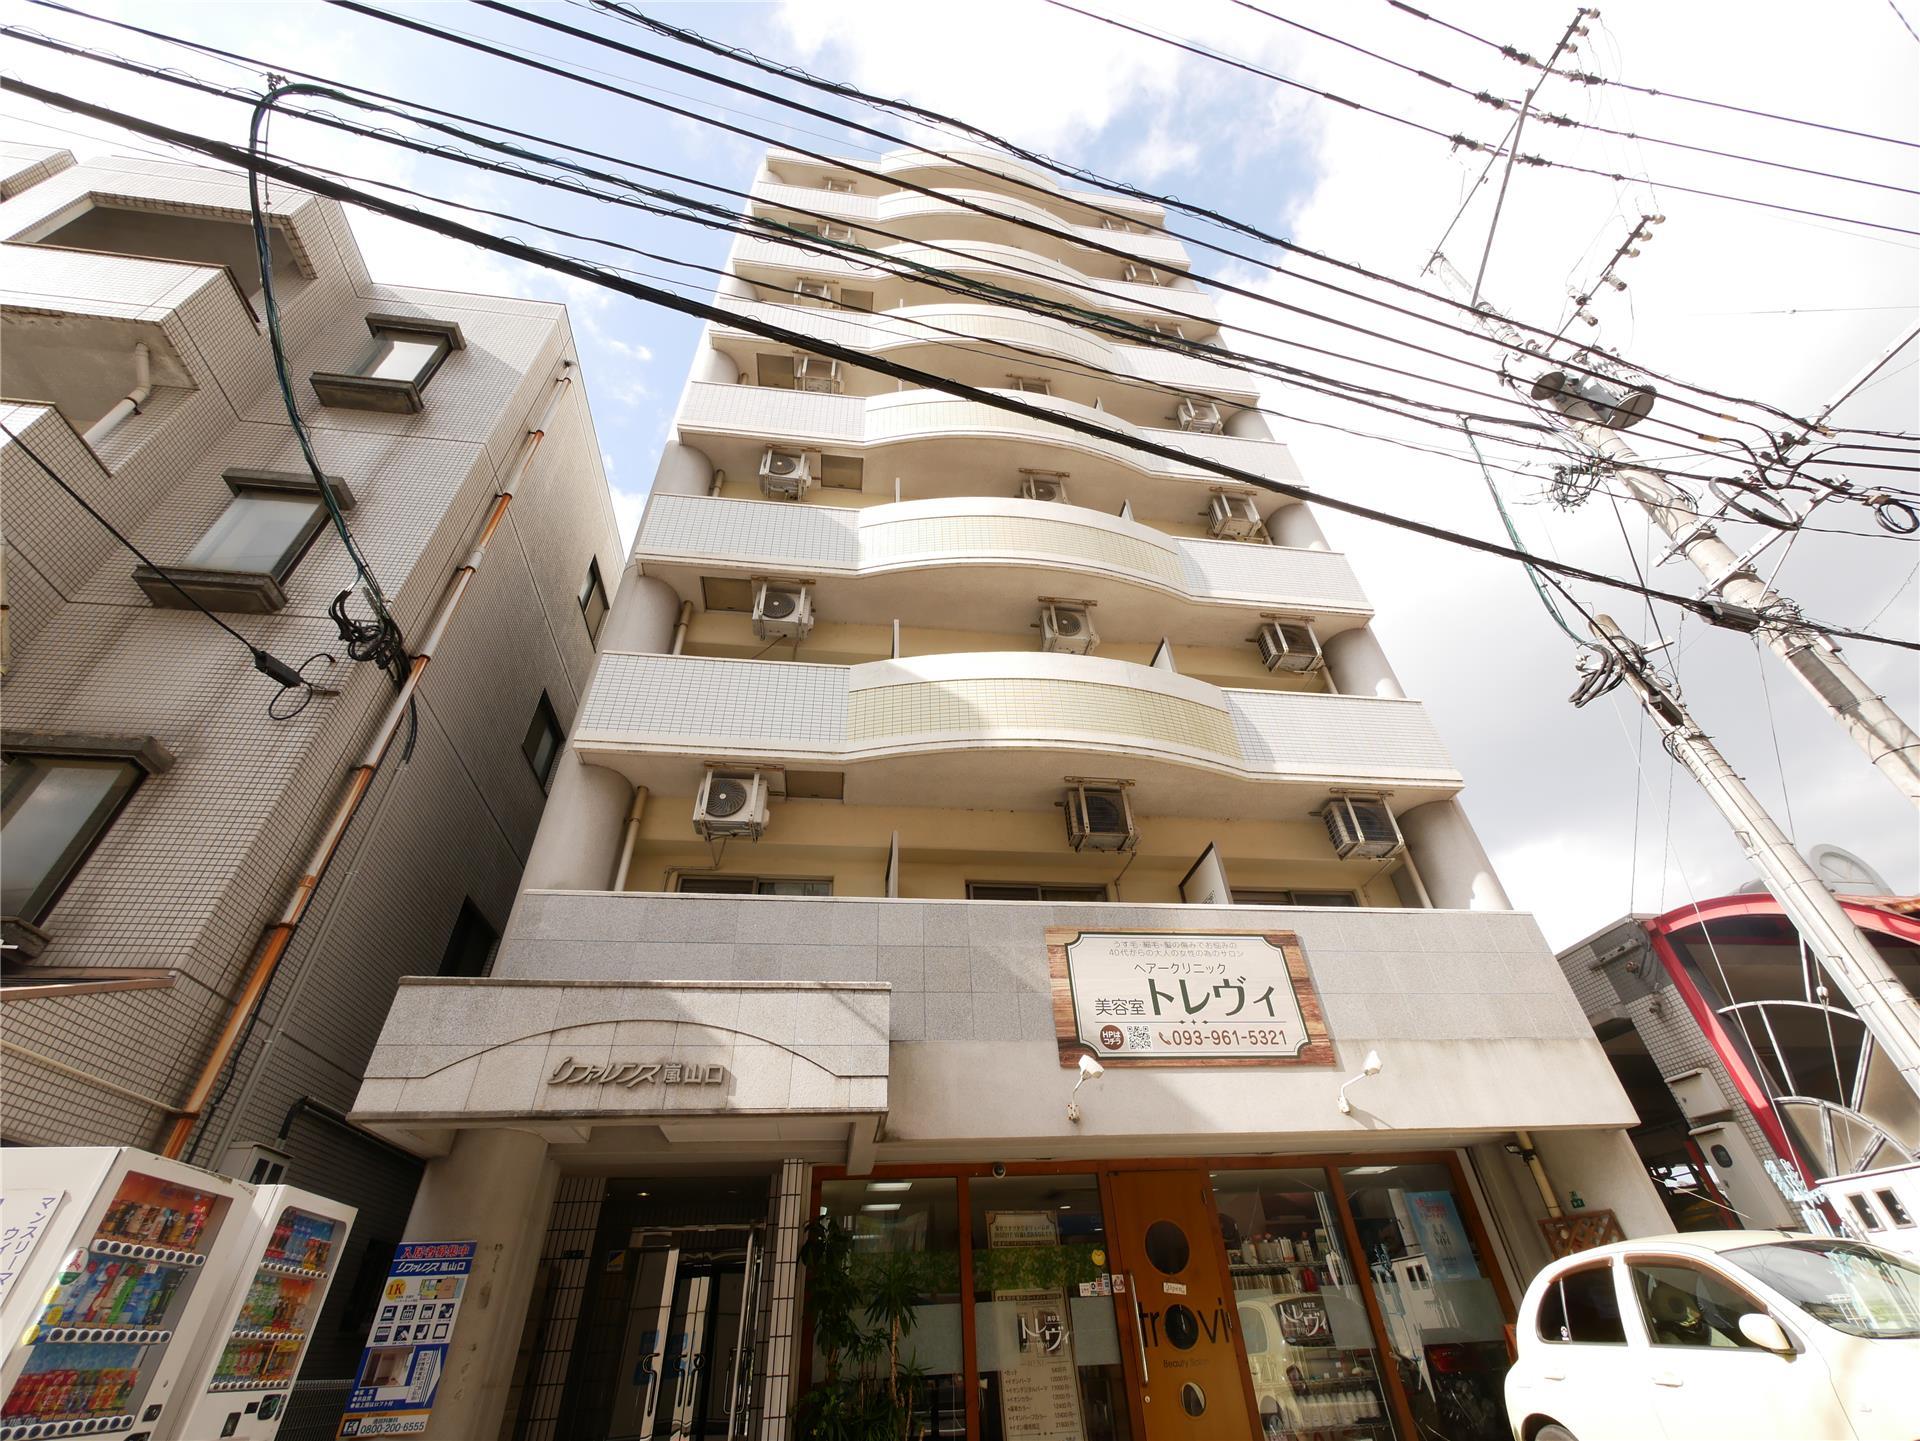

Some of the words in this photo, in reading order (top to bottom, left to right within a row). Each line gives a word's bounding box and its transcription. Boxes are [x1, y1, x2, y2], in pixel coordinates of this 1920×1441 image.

[1134, 962, 1226, 975] ヘアークリニック
[1095, 998, 1147, 1016] 美容室
[1147, 976, 1276, 1018] トレヴィ
[1102, 1030, 1122, 1039] HPは
[1103, 1038, 1122, 1046] コチラ
[1172, 1029, 1288, 1047] 093-961-5321
[1279, 1303, 1327, 1337] トレヴィ
[1021, 1316, 1070, 1352] トレヴィ
[360, 1421, 425, 1435] 0800-200-6555
